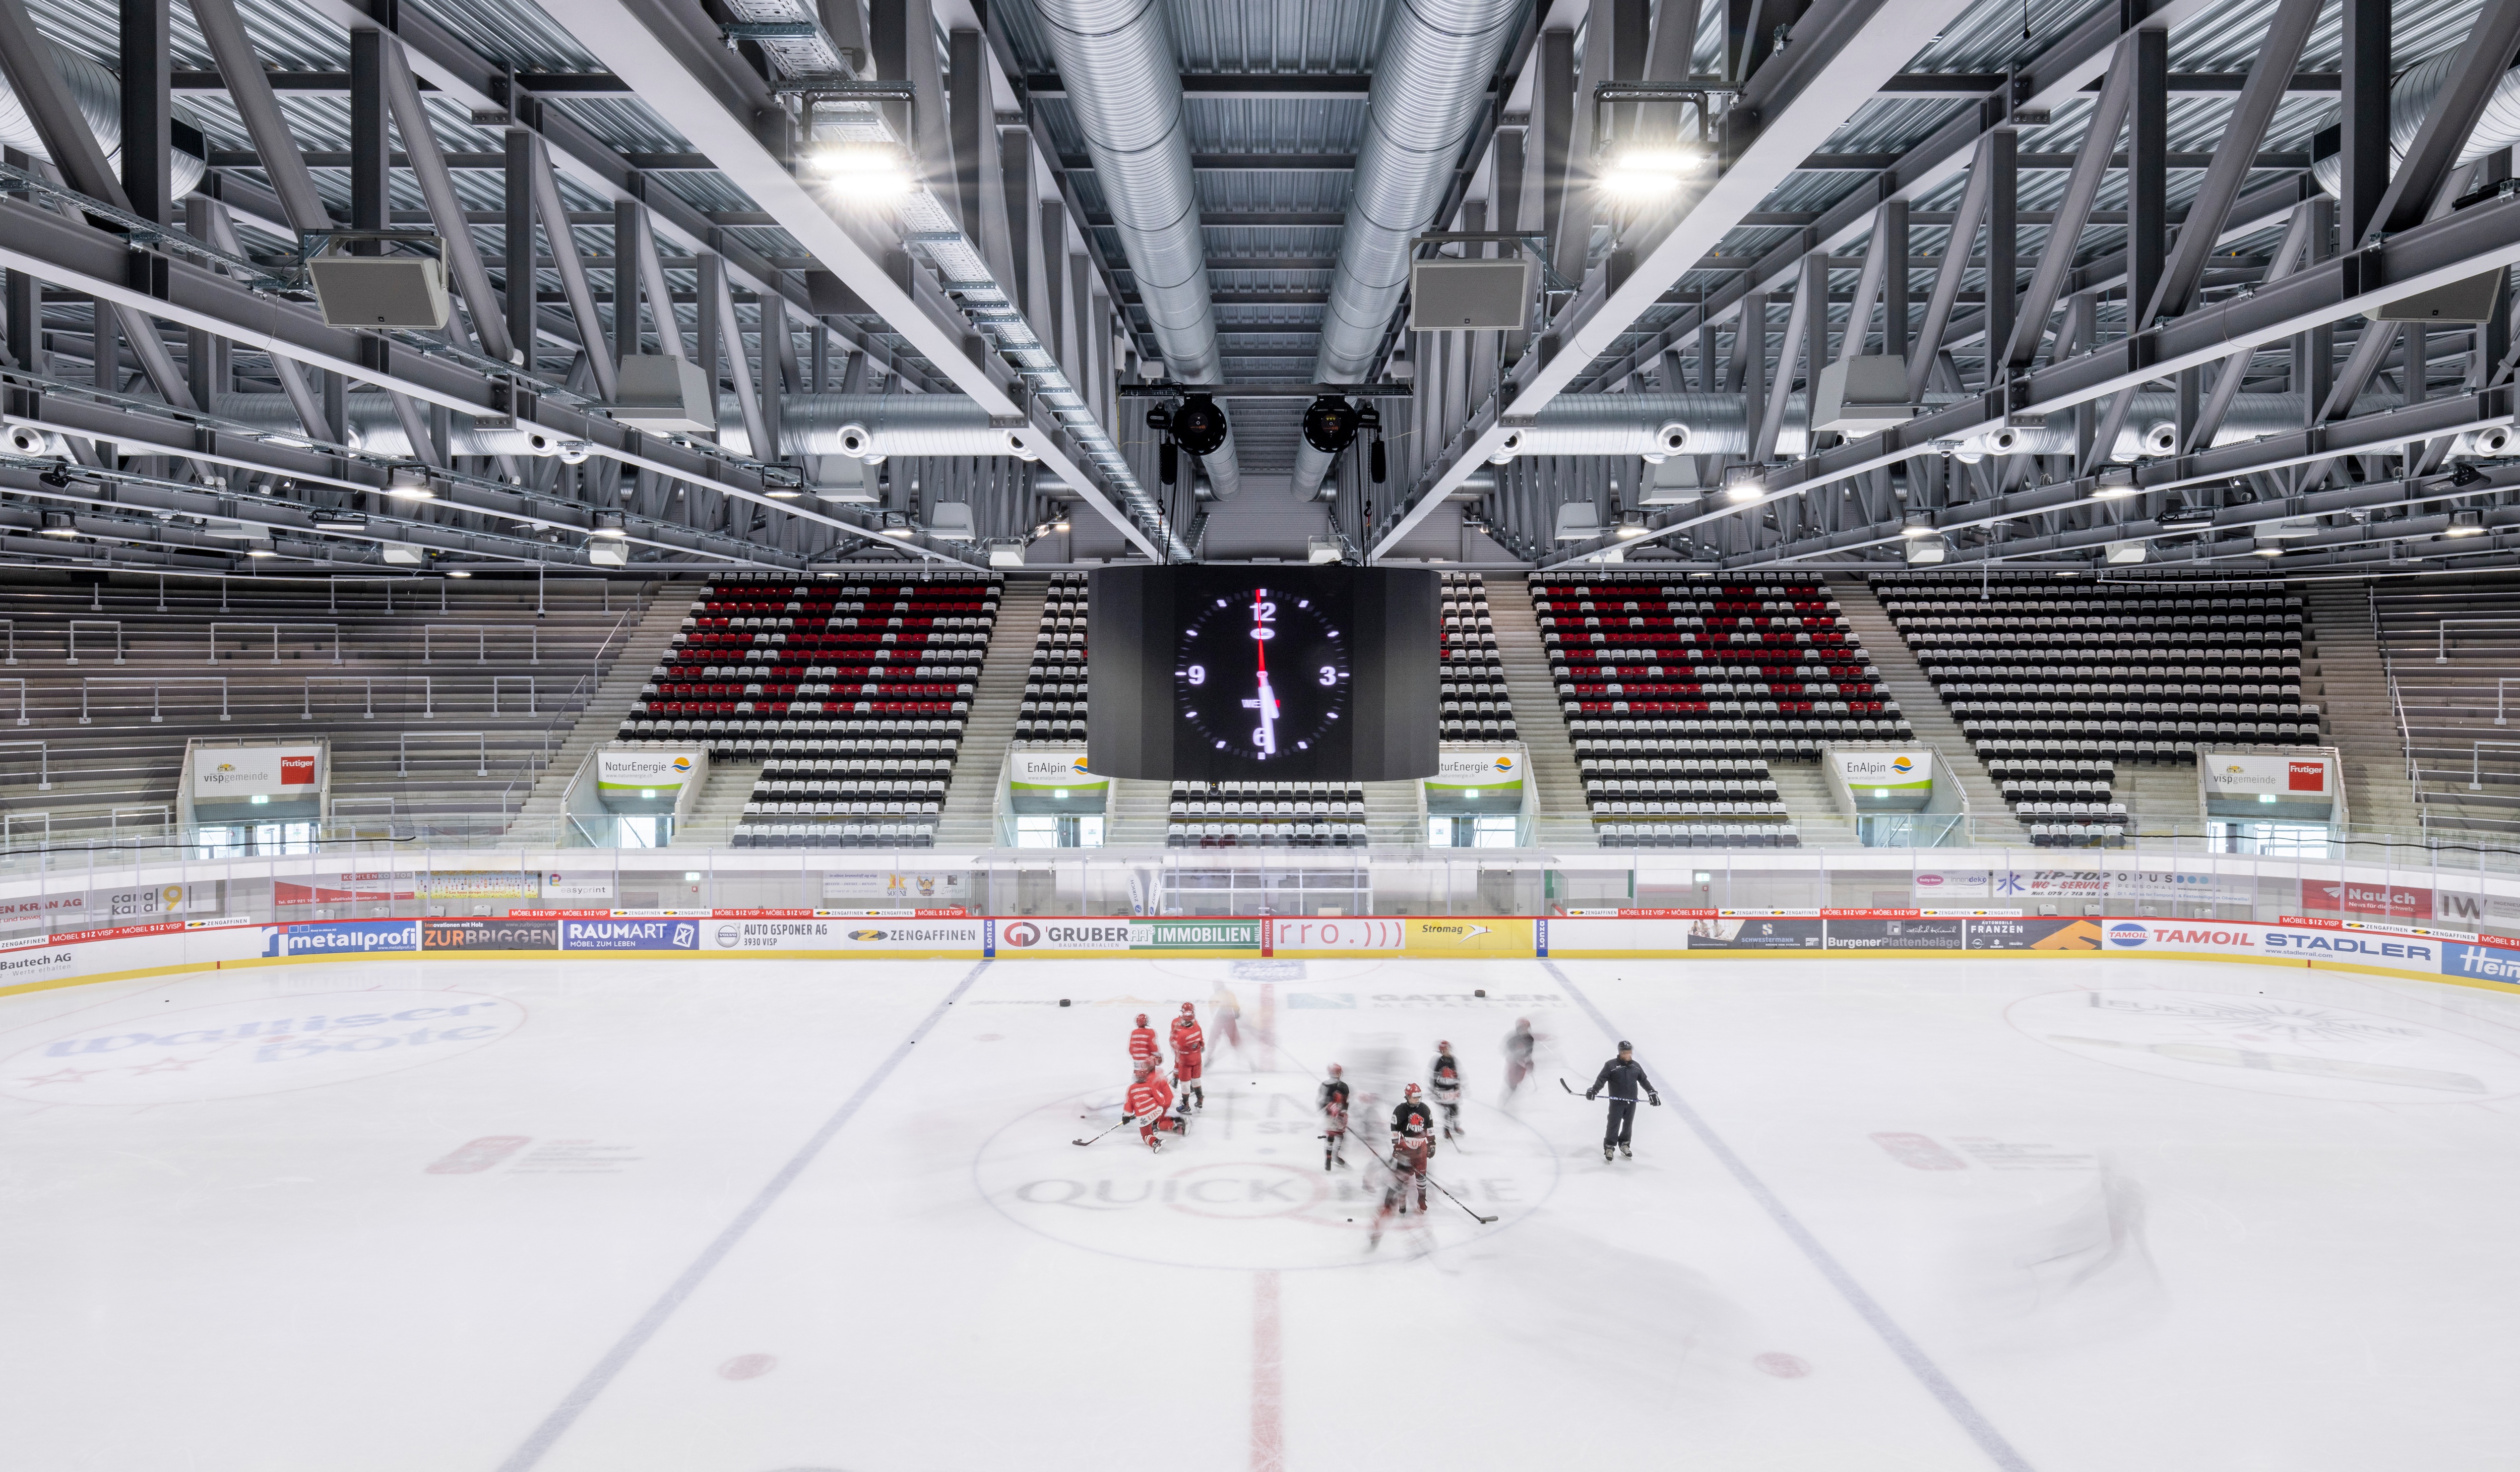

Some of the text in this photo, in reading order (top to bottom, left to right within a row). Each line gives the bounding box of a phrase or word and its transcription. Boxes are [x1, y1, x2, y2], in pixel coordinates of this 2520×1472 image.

[1249, 602, 1276, 621] 12
[1188, 665, 1205, 685] 9
[1319, 666, 1337, 685] 3
[282, 760, 313, 768] Frutiger
[605, 762, 667, 773] NaturEnergie
[1028, 762, 1066, 775] EnAlpin
[1847, 762, 1886, 774] EnAlpin
[2290, 765, 2322, 774] Frutiger
[561, 886, 606, 895] easyprint
[1130, 880, 1139, 902] ZURICH
[62, 898, 82, 907] AG
[4, 914, 18, 923] und
[207, 917, 247, 926] ZENGAFFINEN
[2283, 916, 2307, 925] MÖBEL
[52, 933, 79, 942] MÖBEL
[122, 926, 148, 935] MÖBEL
[166, 922, 182, 930] VISP
[570, 924, 667, 939] RAUMART
[744, 924, 827, 936] AUTO GSPONER AG
[1422, 925, 1463, 934] Stromag
[2366, 924, 2408, 933] ZENGAFFINEN
[289, 928, 415, 950] metallprofi
[424, 929, 556, 946] ZURBRIGGEN
[891, 930, 976, 941] ZENGAFFINEN
[1158, 928, 1250, 942] IMMOBILIEN
[2153, 929, 2255, 946] TAMOIL
[2432, 930, 2475, 940] ZENGAFFINEN
[2482, 936, 2508, 945] MÖBEL
[2, 937, 46, 948] ZENGAFFINEN
[2265, 933, 2431, 961] STADLER
[2265, 949, 2333, 958] www.stadlerrail.com
[0, 953, 72, 970] Bautech AG
[12, 963, 71, 976] Werte erhalten
[1148, 1109, 1162, 1122] UBS
